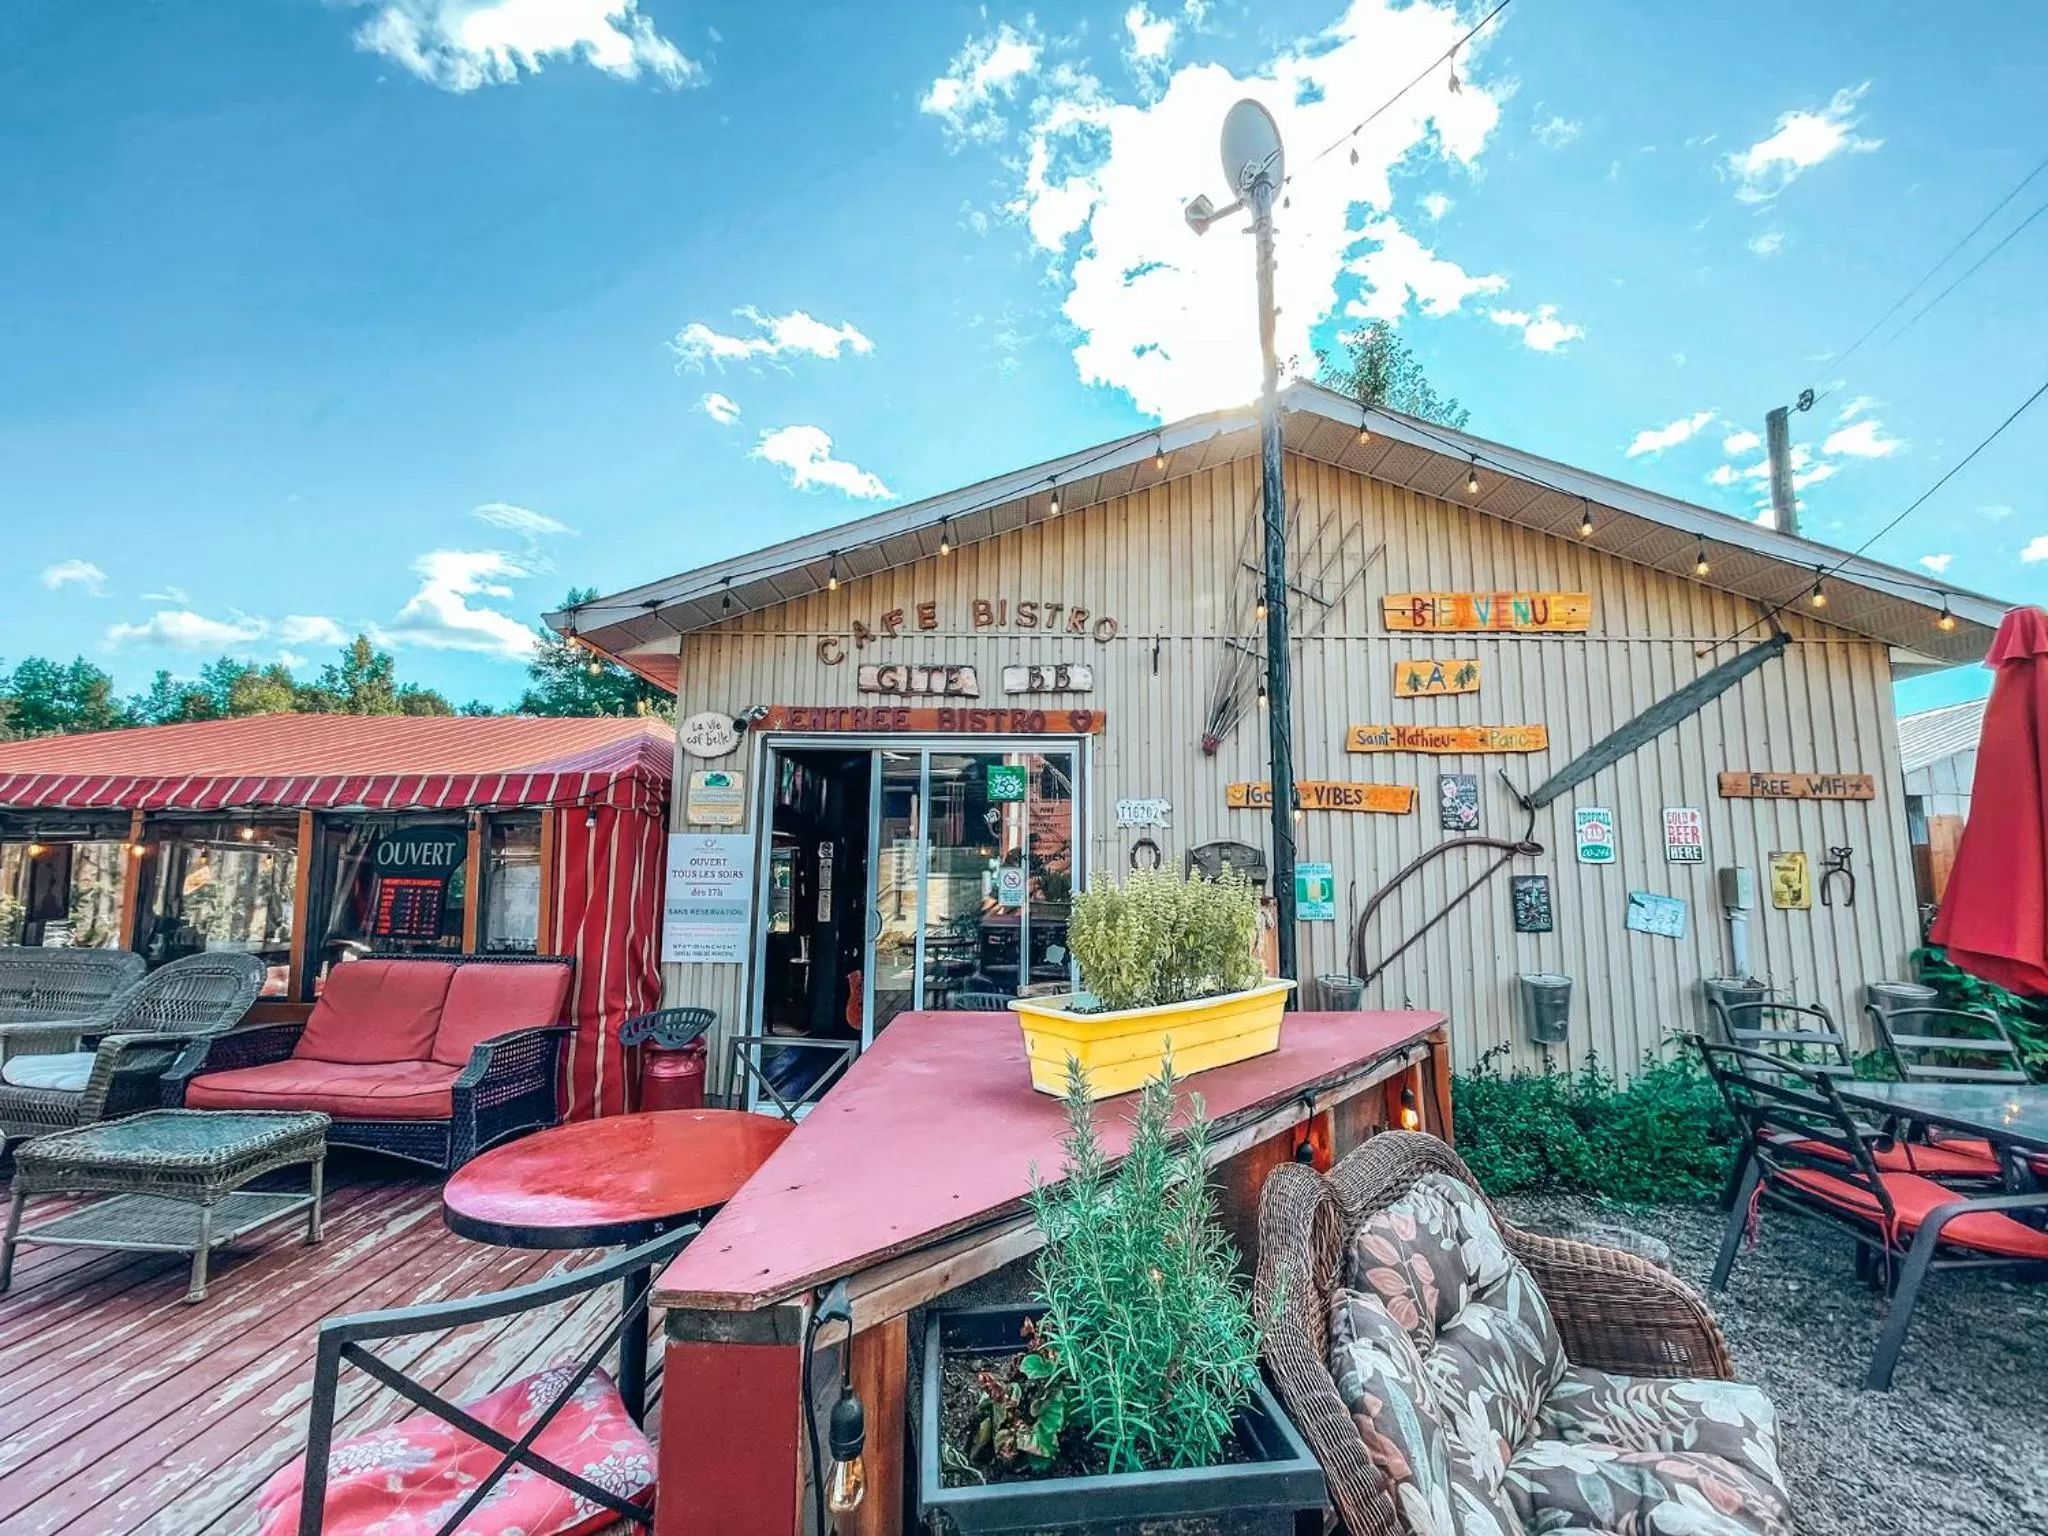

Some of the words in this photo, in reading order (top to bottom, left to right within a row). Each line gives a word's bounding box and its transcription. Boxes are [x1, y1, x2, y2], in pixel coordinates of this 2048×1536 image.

[816, 600, 938, 665] CAFE
[972, 599, 1118, 643] BISTRO
[877, 665, 962, 694] GITE
[1426, 661, 1447, 690] À
[692, 722, 704, 732] La
[708, 720, 722, 730] vie
[786, 706, 912, 731] ENTREE
[936, 708, 1047, 733] BISTRO
[1750, 774, 1791, 795] FREE
[1805, 775, 1847, 795] WIFI
[1314, 786, 1363, 805] VIBES
[1667, 825, 1700, 845] BEER
[377, 841, 457, 866] OUVERT
[690, 858, 728, 867] OUVERT
[1671, 846, 1701, 860] HERE
[671, 870, 697, 878] TOUS
[698, 870, 716, 878] LES
[717, 870, 744, 878] SOIRS
[707, 888, 723, 896] 17h
